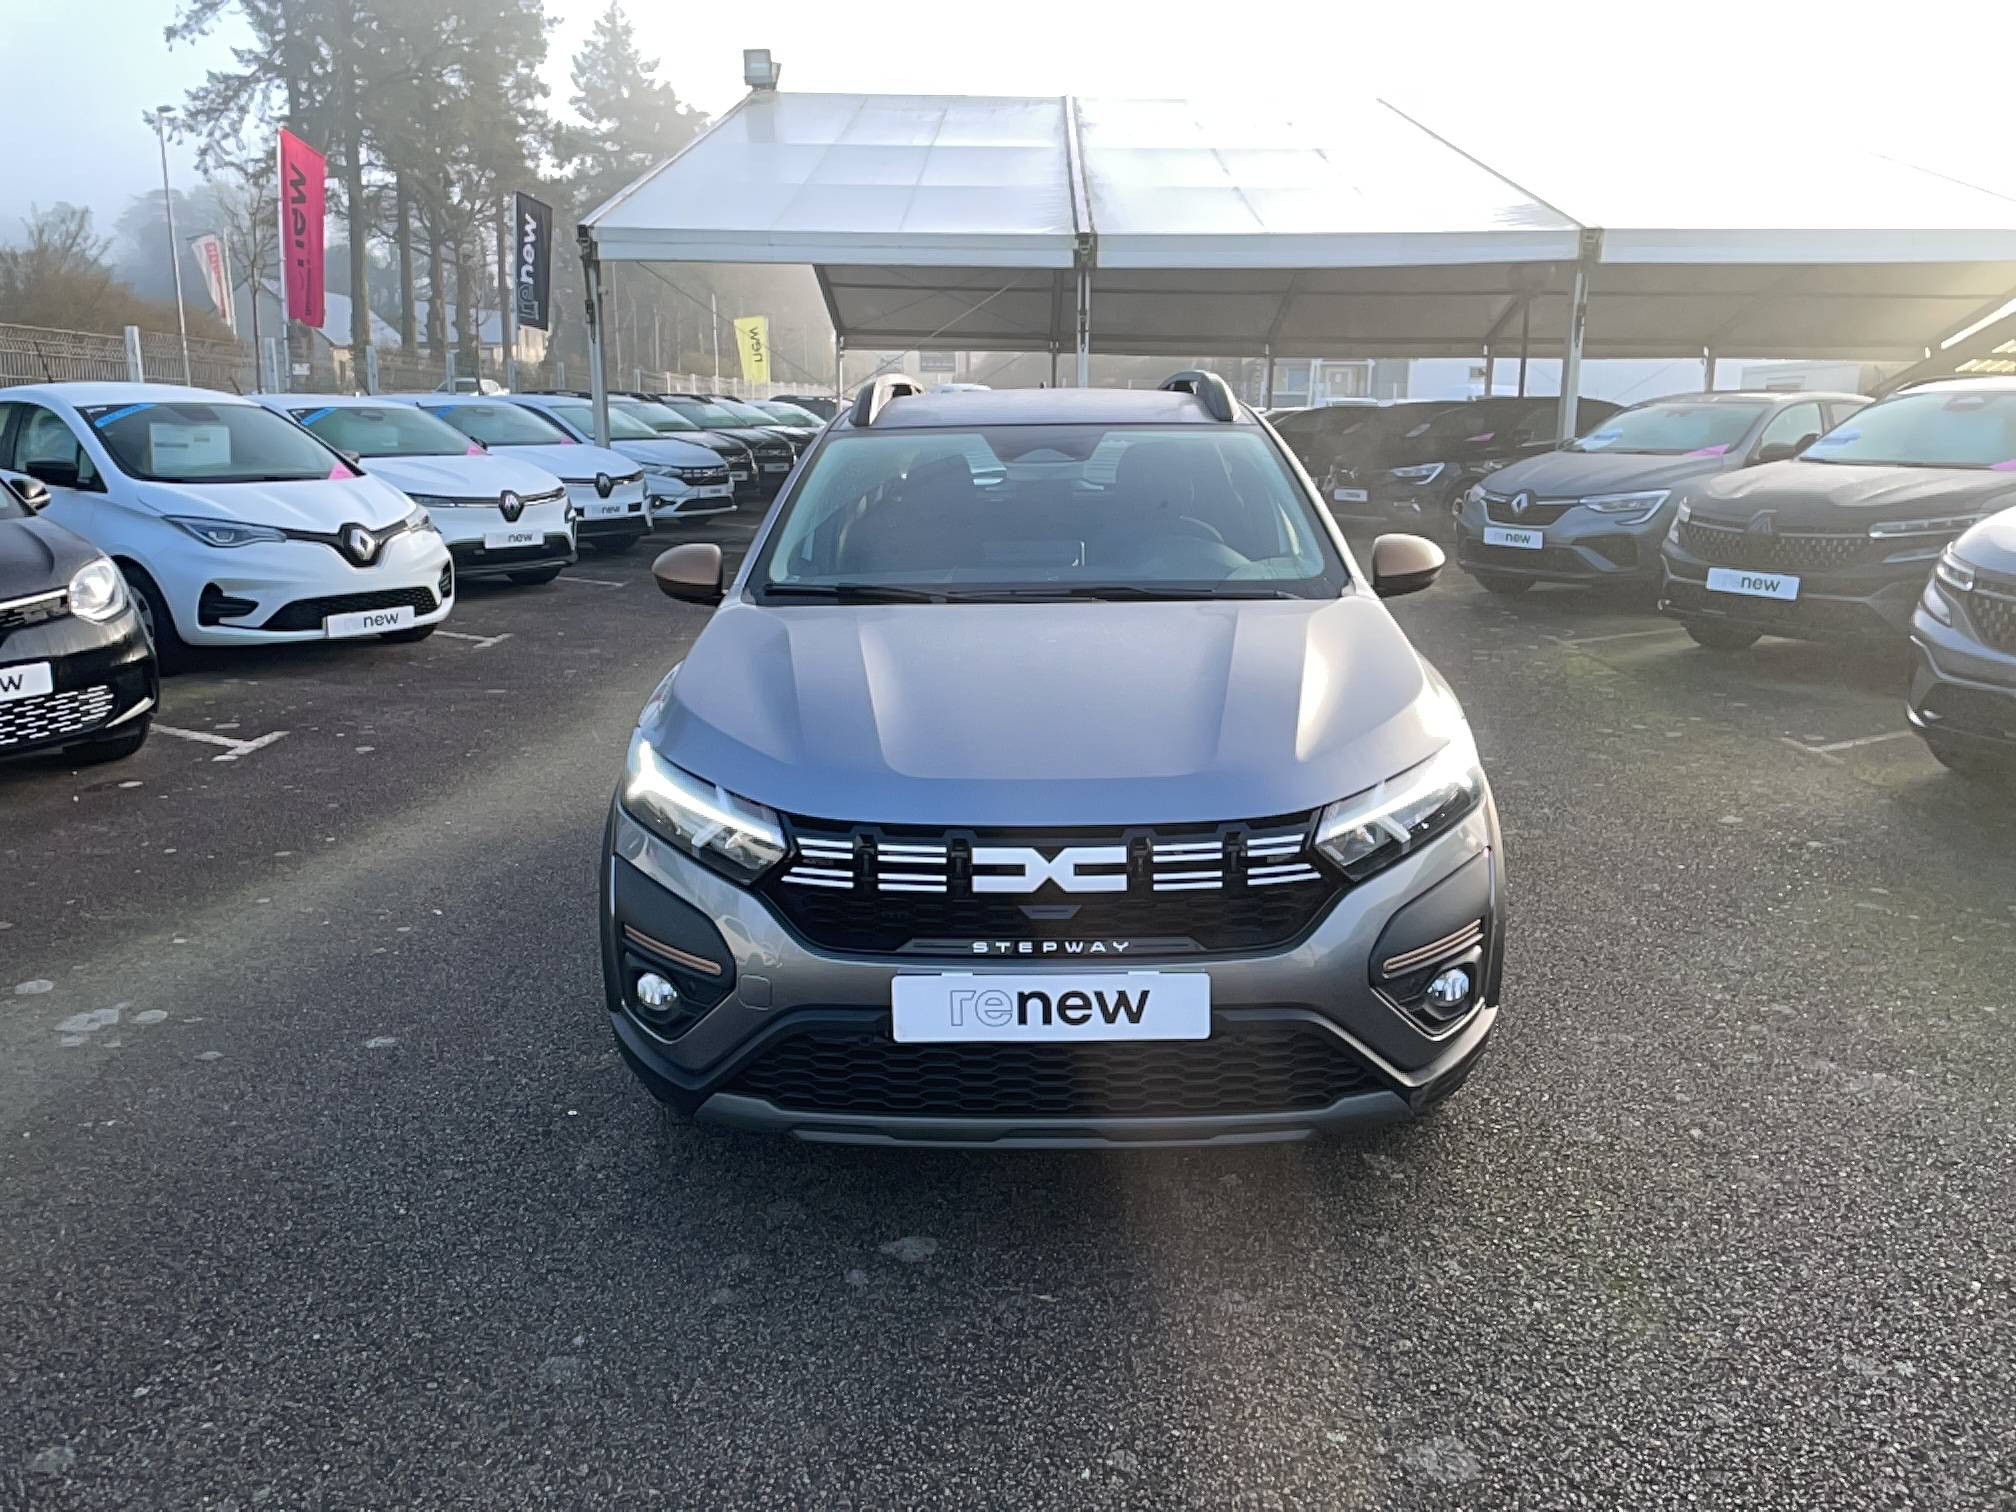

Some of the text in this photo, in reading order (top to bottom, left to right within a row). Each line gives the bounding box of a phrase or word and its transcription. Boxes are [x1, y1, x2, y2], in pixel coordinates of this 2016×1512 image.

[363, 612, 399, 628] new
[972, 940, 1130, 954] STEPWAY
[949, 989, 1151, 1027] renew
